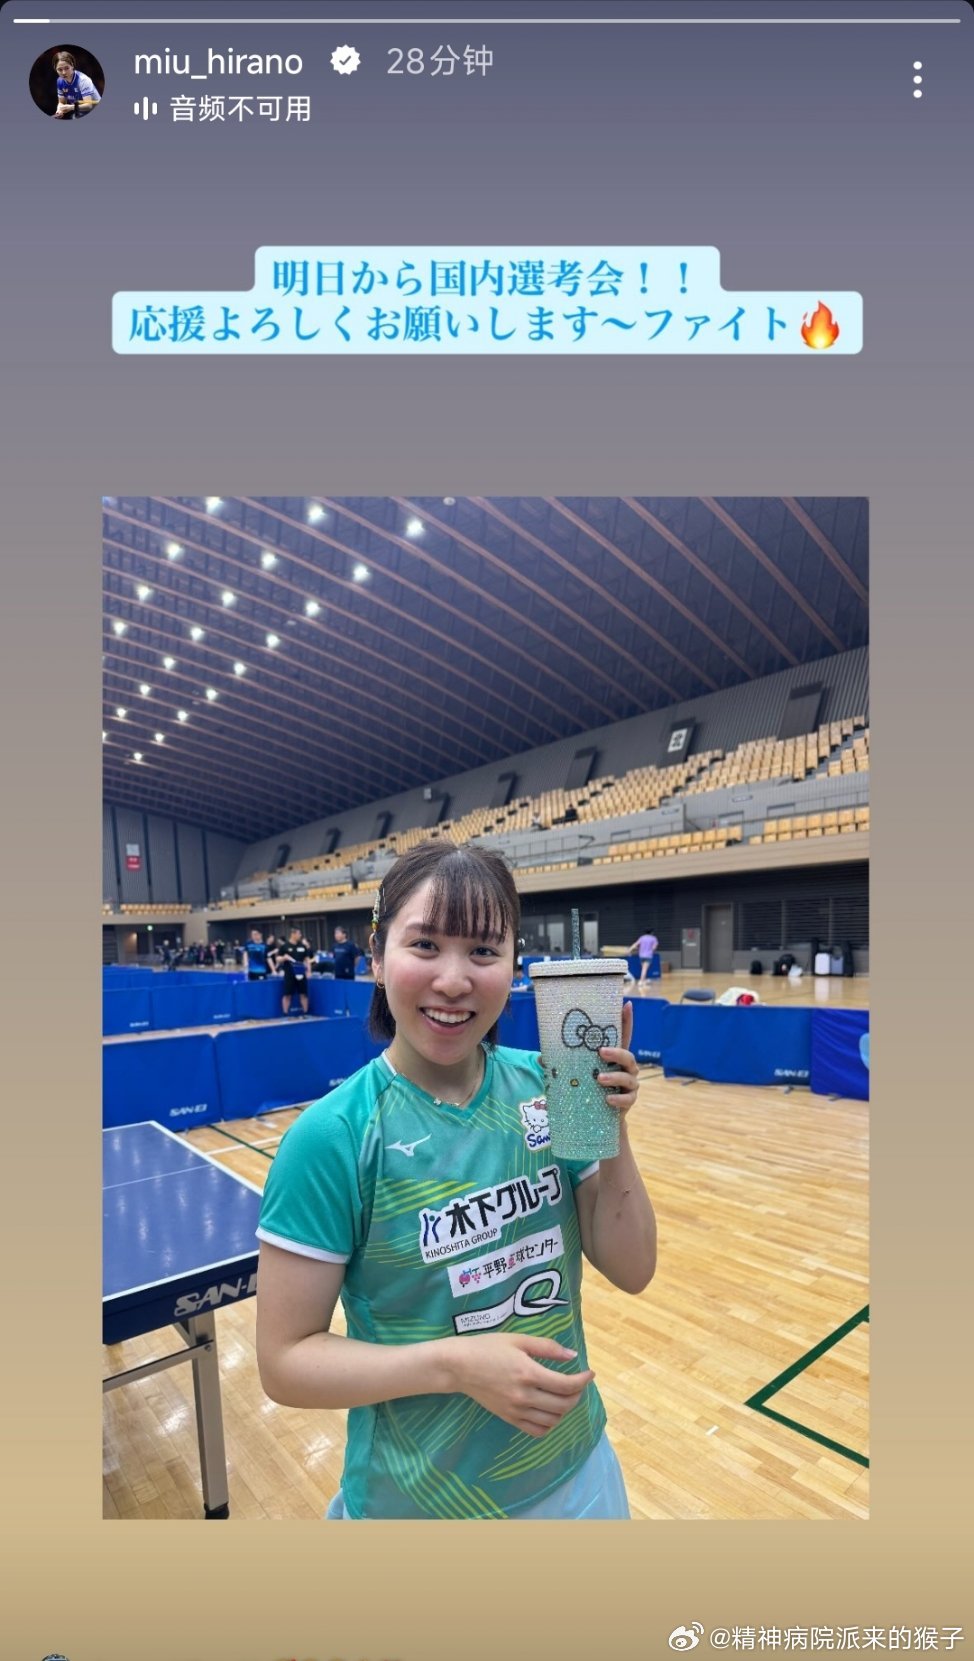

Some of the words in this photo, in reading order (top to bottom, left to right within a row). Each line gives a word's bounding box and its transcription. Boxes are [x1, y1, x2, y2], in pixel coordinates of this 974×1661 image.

[445, 1167, 561, 1238] 木下グループ
[425, 1239, 471, 1259] KINOSHITA
[471, 1228, 498, 1245] GROUP
